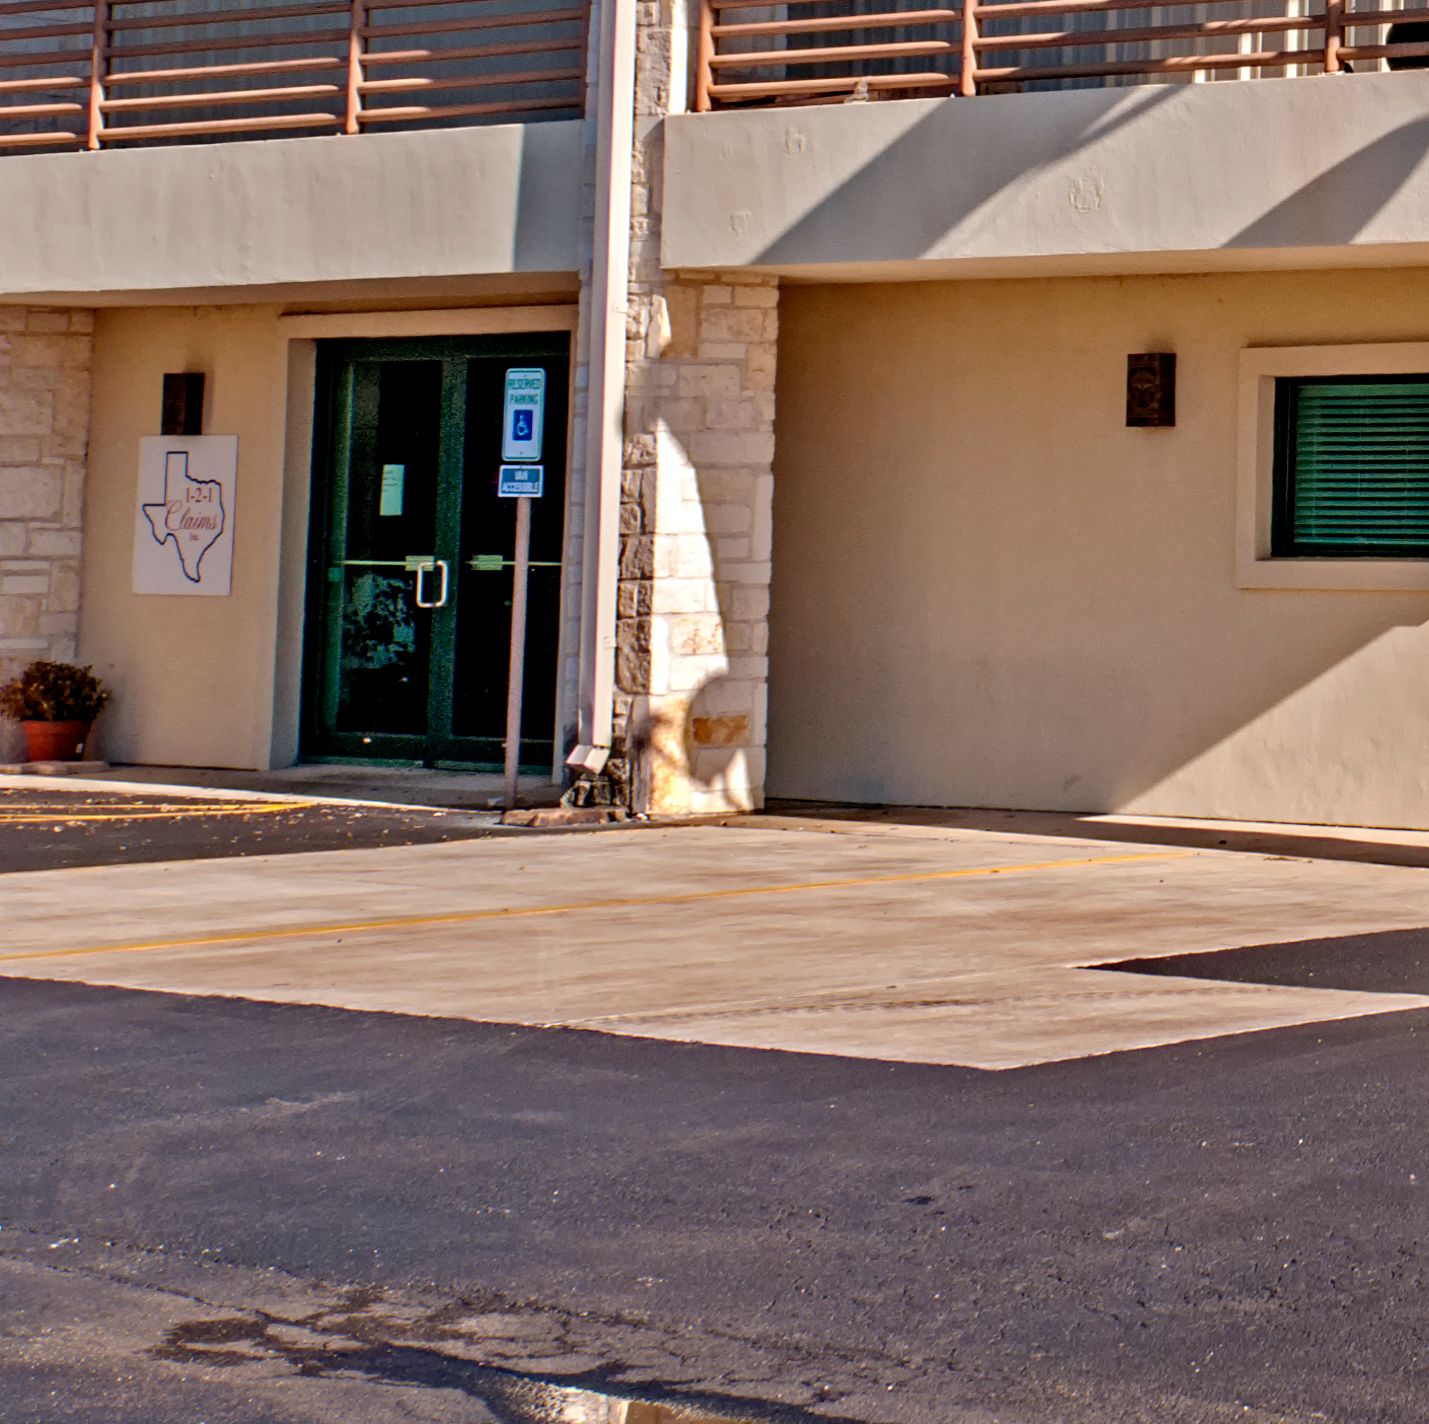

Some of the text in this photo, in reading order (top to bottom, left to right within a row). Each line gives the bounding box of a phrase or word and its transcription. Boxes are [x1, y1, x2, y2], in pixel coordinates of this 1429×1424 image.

[510, 394, 539, 405] PARKING
[186, 487, 212, 503] 1-2-1
[165, 500, 218, 532] Claims
